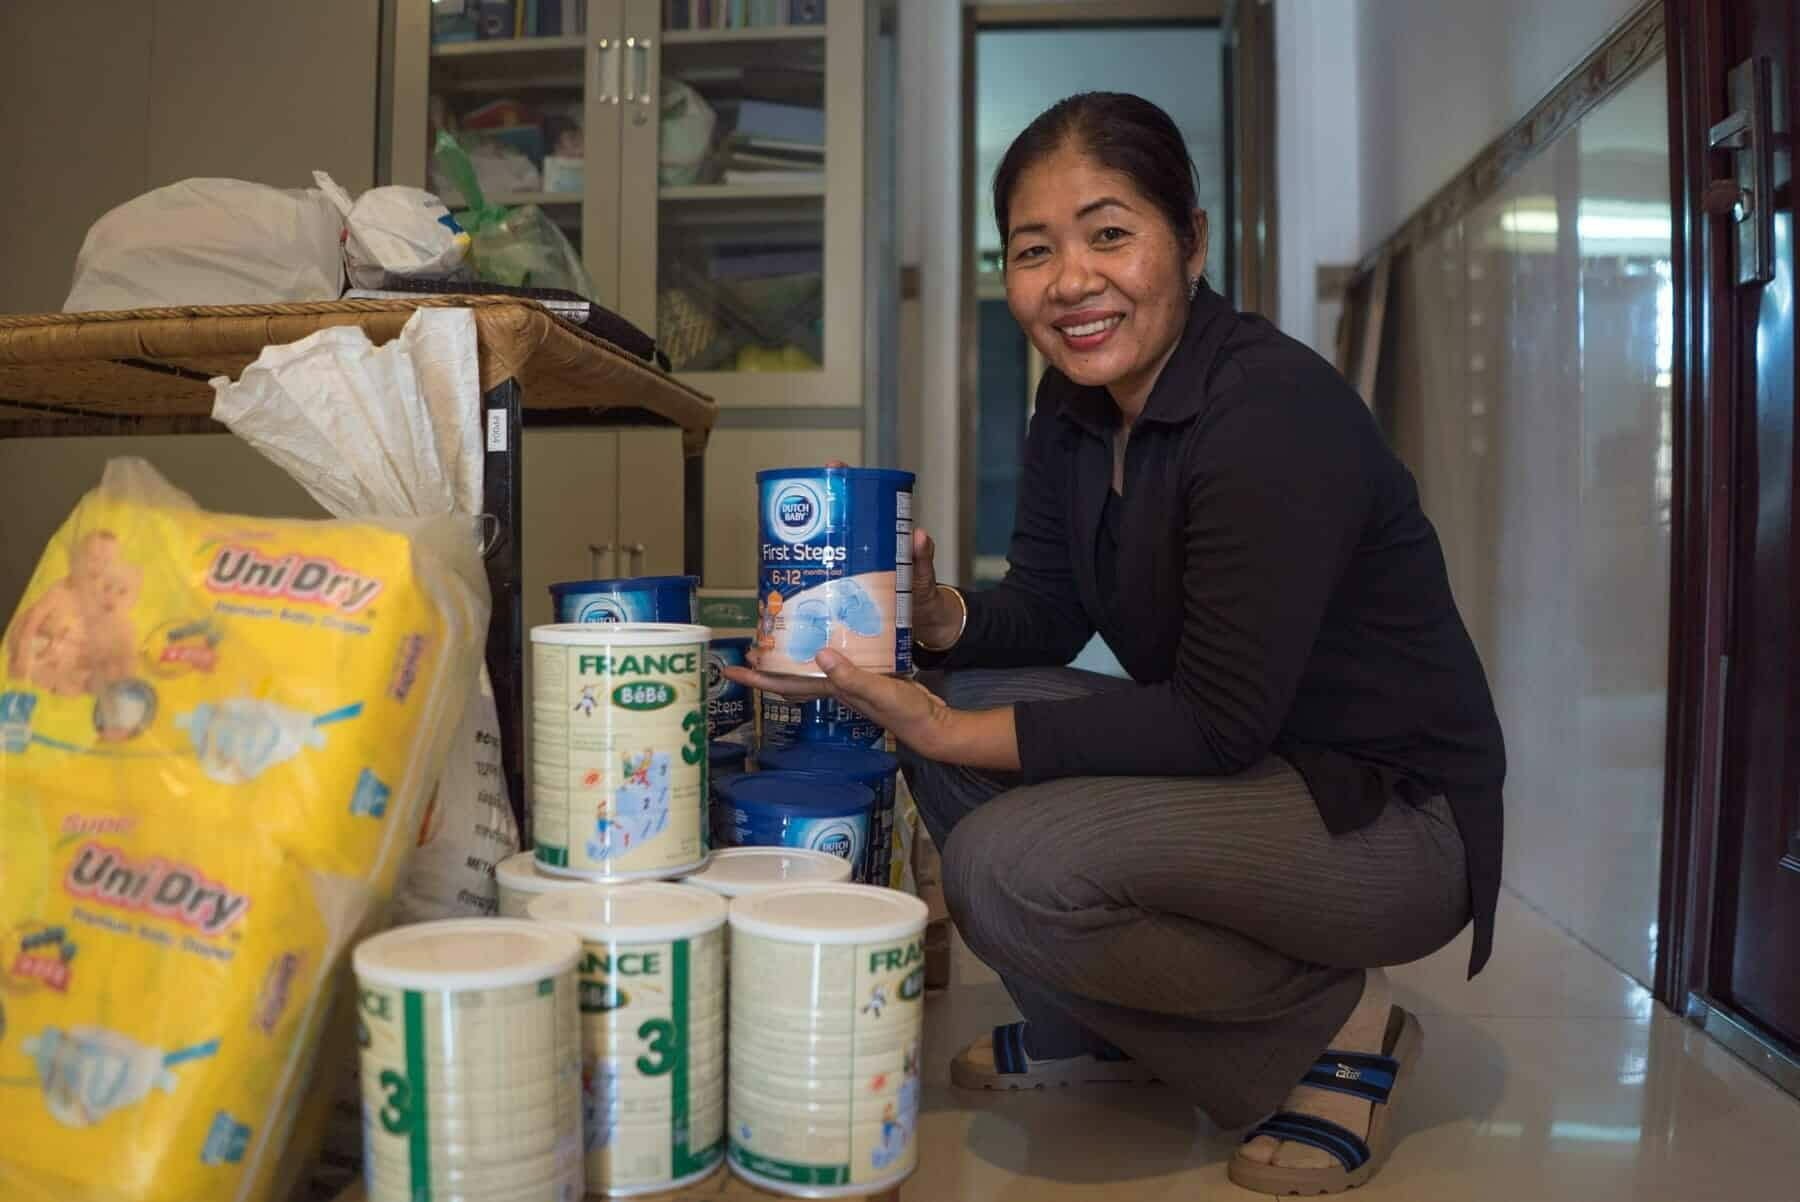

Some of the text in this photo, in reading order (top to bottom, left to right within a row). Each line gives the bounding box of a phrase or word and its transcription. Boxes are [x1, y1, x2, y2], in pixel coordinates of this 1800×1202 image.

[782, 503, 810, 514] DUTCH
[784, 513, 807, 521] BABY
[763, 544, 848, 567] First Steps
[772, 570, 801, 584] 6-12
[579, 653, 696, 676] FRANCE
[620, 686, 667, 703] BéBé
[708, 699, 744, 716] Steps
[681, 709, 705, 765] 3
[869, 943, 922, 975] FRA
[635, 1017, 677, 1077] 3
[380, 1069, 412, 1136] 3
